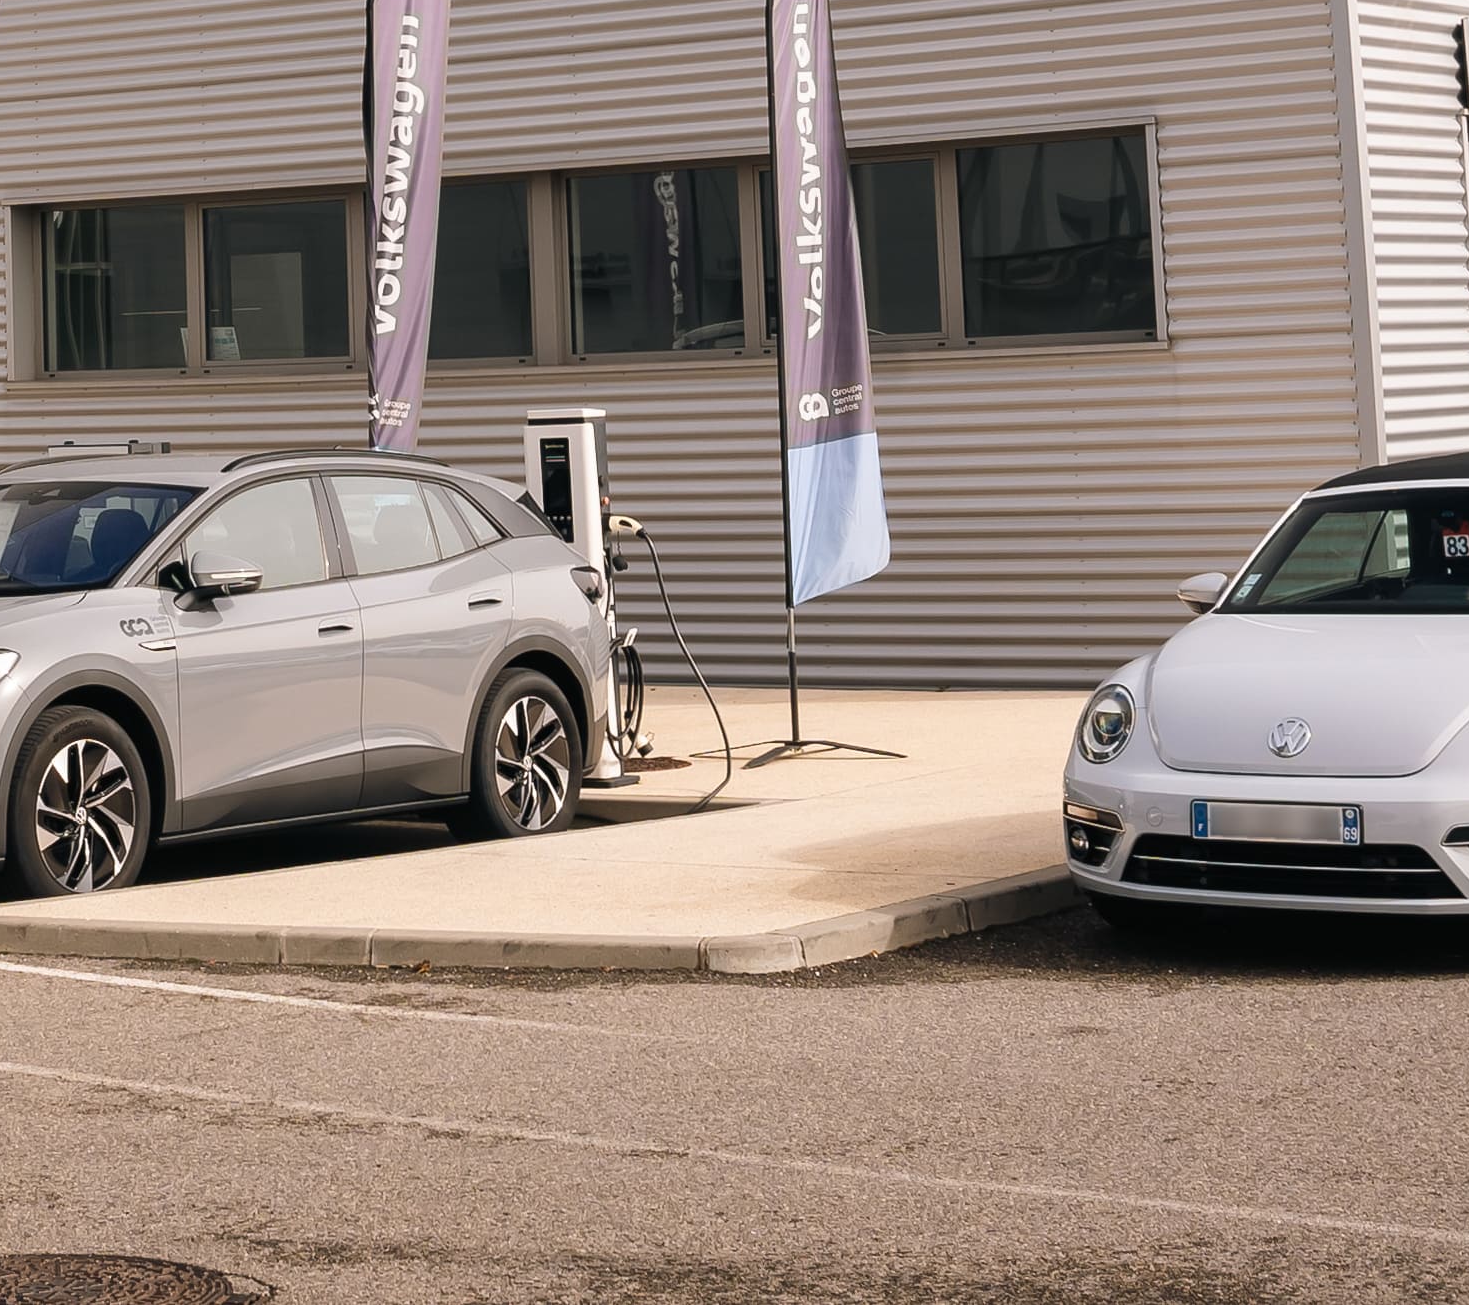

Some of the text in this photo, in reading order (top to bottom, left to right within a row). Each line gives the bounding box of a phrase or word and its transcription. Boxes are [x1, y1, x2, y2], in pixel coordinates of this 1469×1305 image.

[374, 13, 425, 337] Volkswagen
[790, 2, 824, 341] Volkswagen
[830, 383, 863, 397] Groupe
[832, 392, 863, 406] central
[834, 403, 860, 415] autos
[1446, 535, 1469, 556] 83
[1343, 827, 1358, 841] 69
